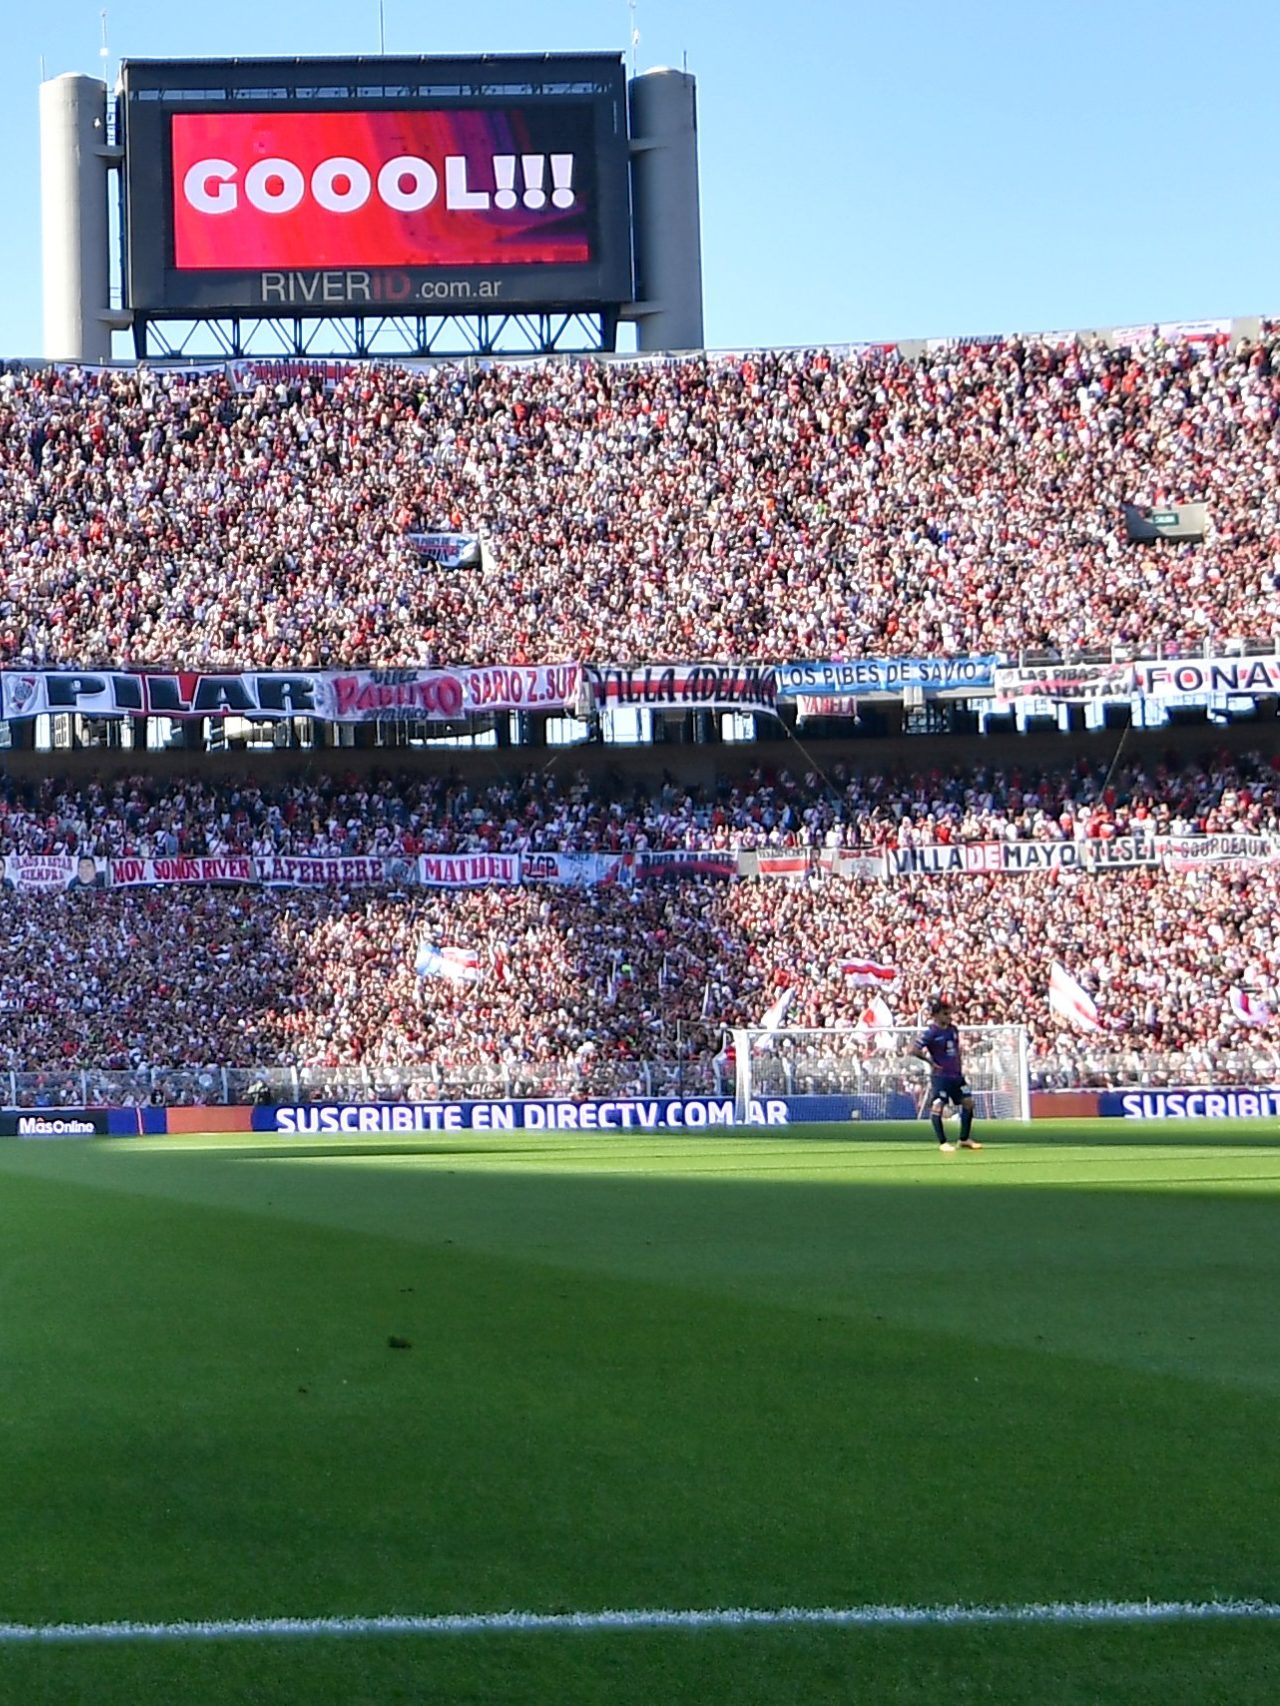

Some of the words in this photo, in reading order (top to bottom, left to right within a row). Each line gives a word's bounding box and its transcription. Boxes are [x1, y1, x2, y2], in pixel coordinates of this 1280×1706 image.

[183, 153, 576, 215] GOOOL!!!
[778, 667, 816, 688] LOS
[823, 663, 880, 686] PIBES
[886, 662, 911, 682] DE
[919, 660, 977, 682] SAVIO
[1145, 661, 1280, 695] FONA
[44, 673, 317, 712] PILAR
[200, 858, 249, 880] RIVER
[424, 857, 514, 882] MATHEU
[895, 848, 964, 873] VILLA
[972, 849, 1000, 869] DE
[1004, 843, 1076, 867] MAYO
[275, 1104, 463, 1135] SUSCRIBITE
[471, 1103, 518, 1131] EN
[523, 1100, 790, 1130] DIRECTV.COM.AR
